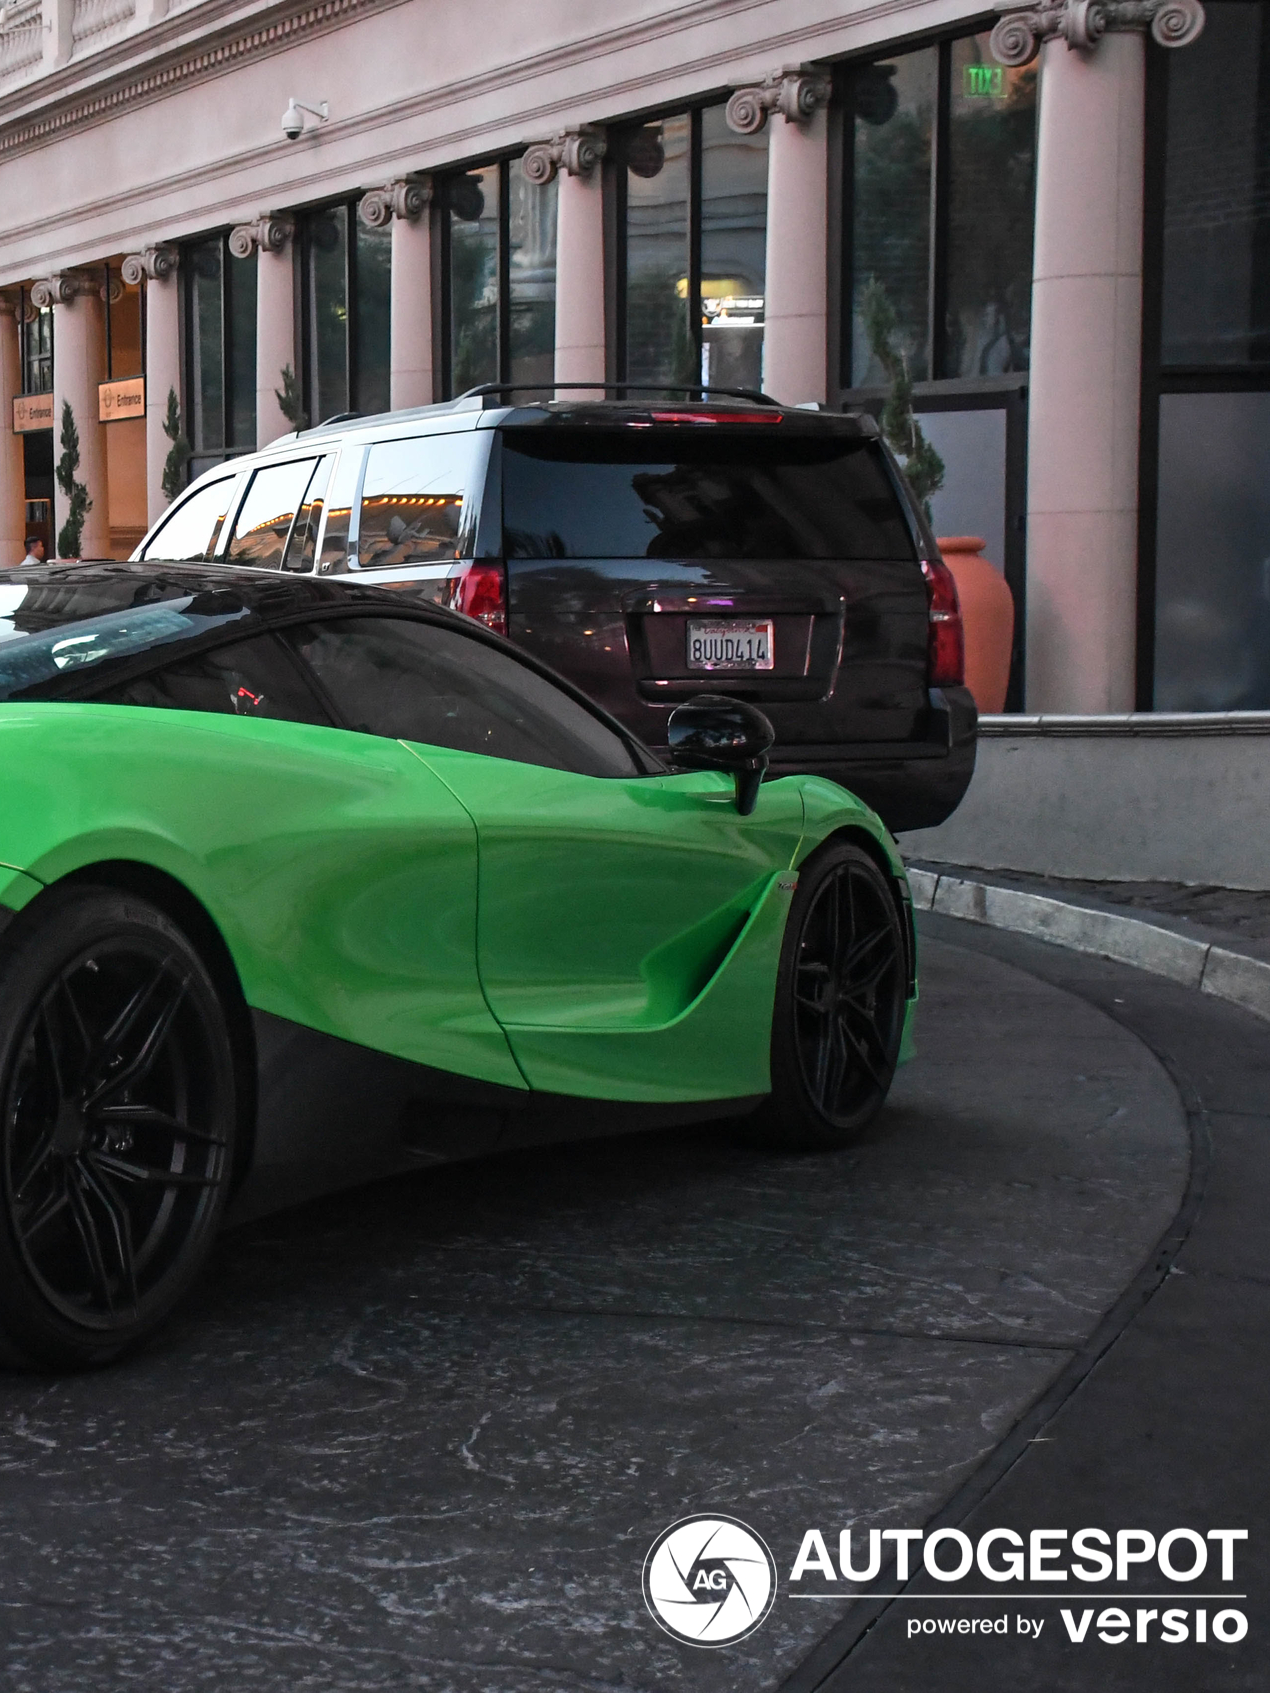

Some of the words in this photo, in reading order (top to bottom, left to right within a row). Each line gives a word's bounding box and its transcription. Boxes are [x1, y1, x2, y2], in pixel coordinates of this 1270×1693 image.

[117, 394, 142, 408] Entrance
[29, 407, 51, 420] Entrance
[693, 638, 766, 662] 8UUD414
